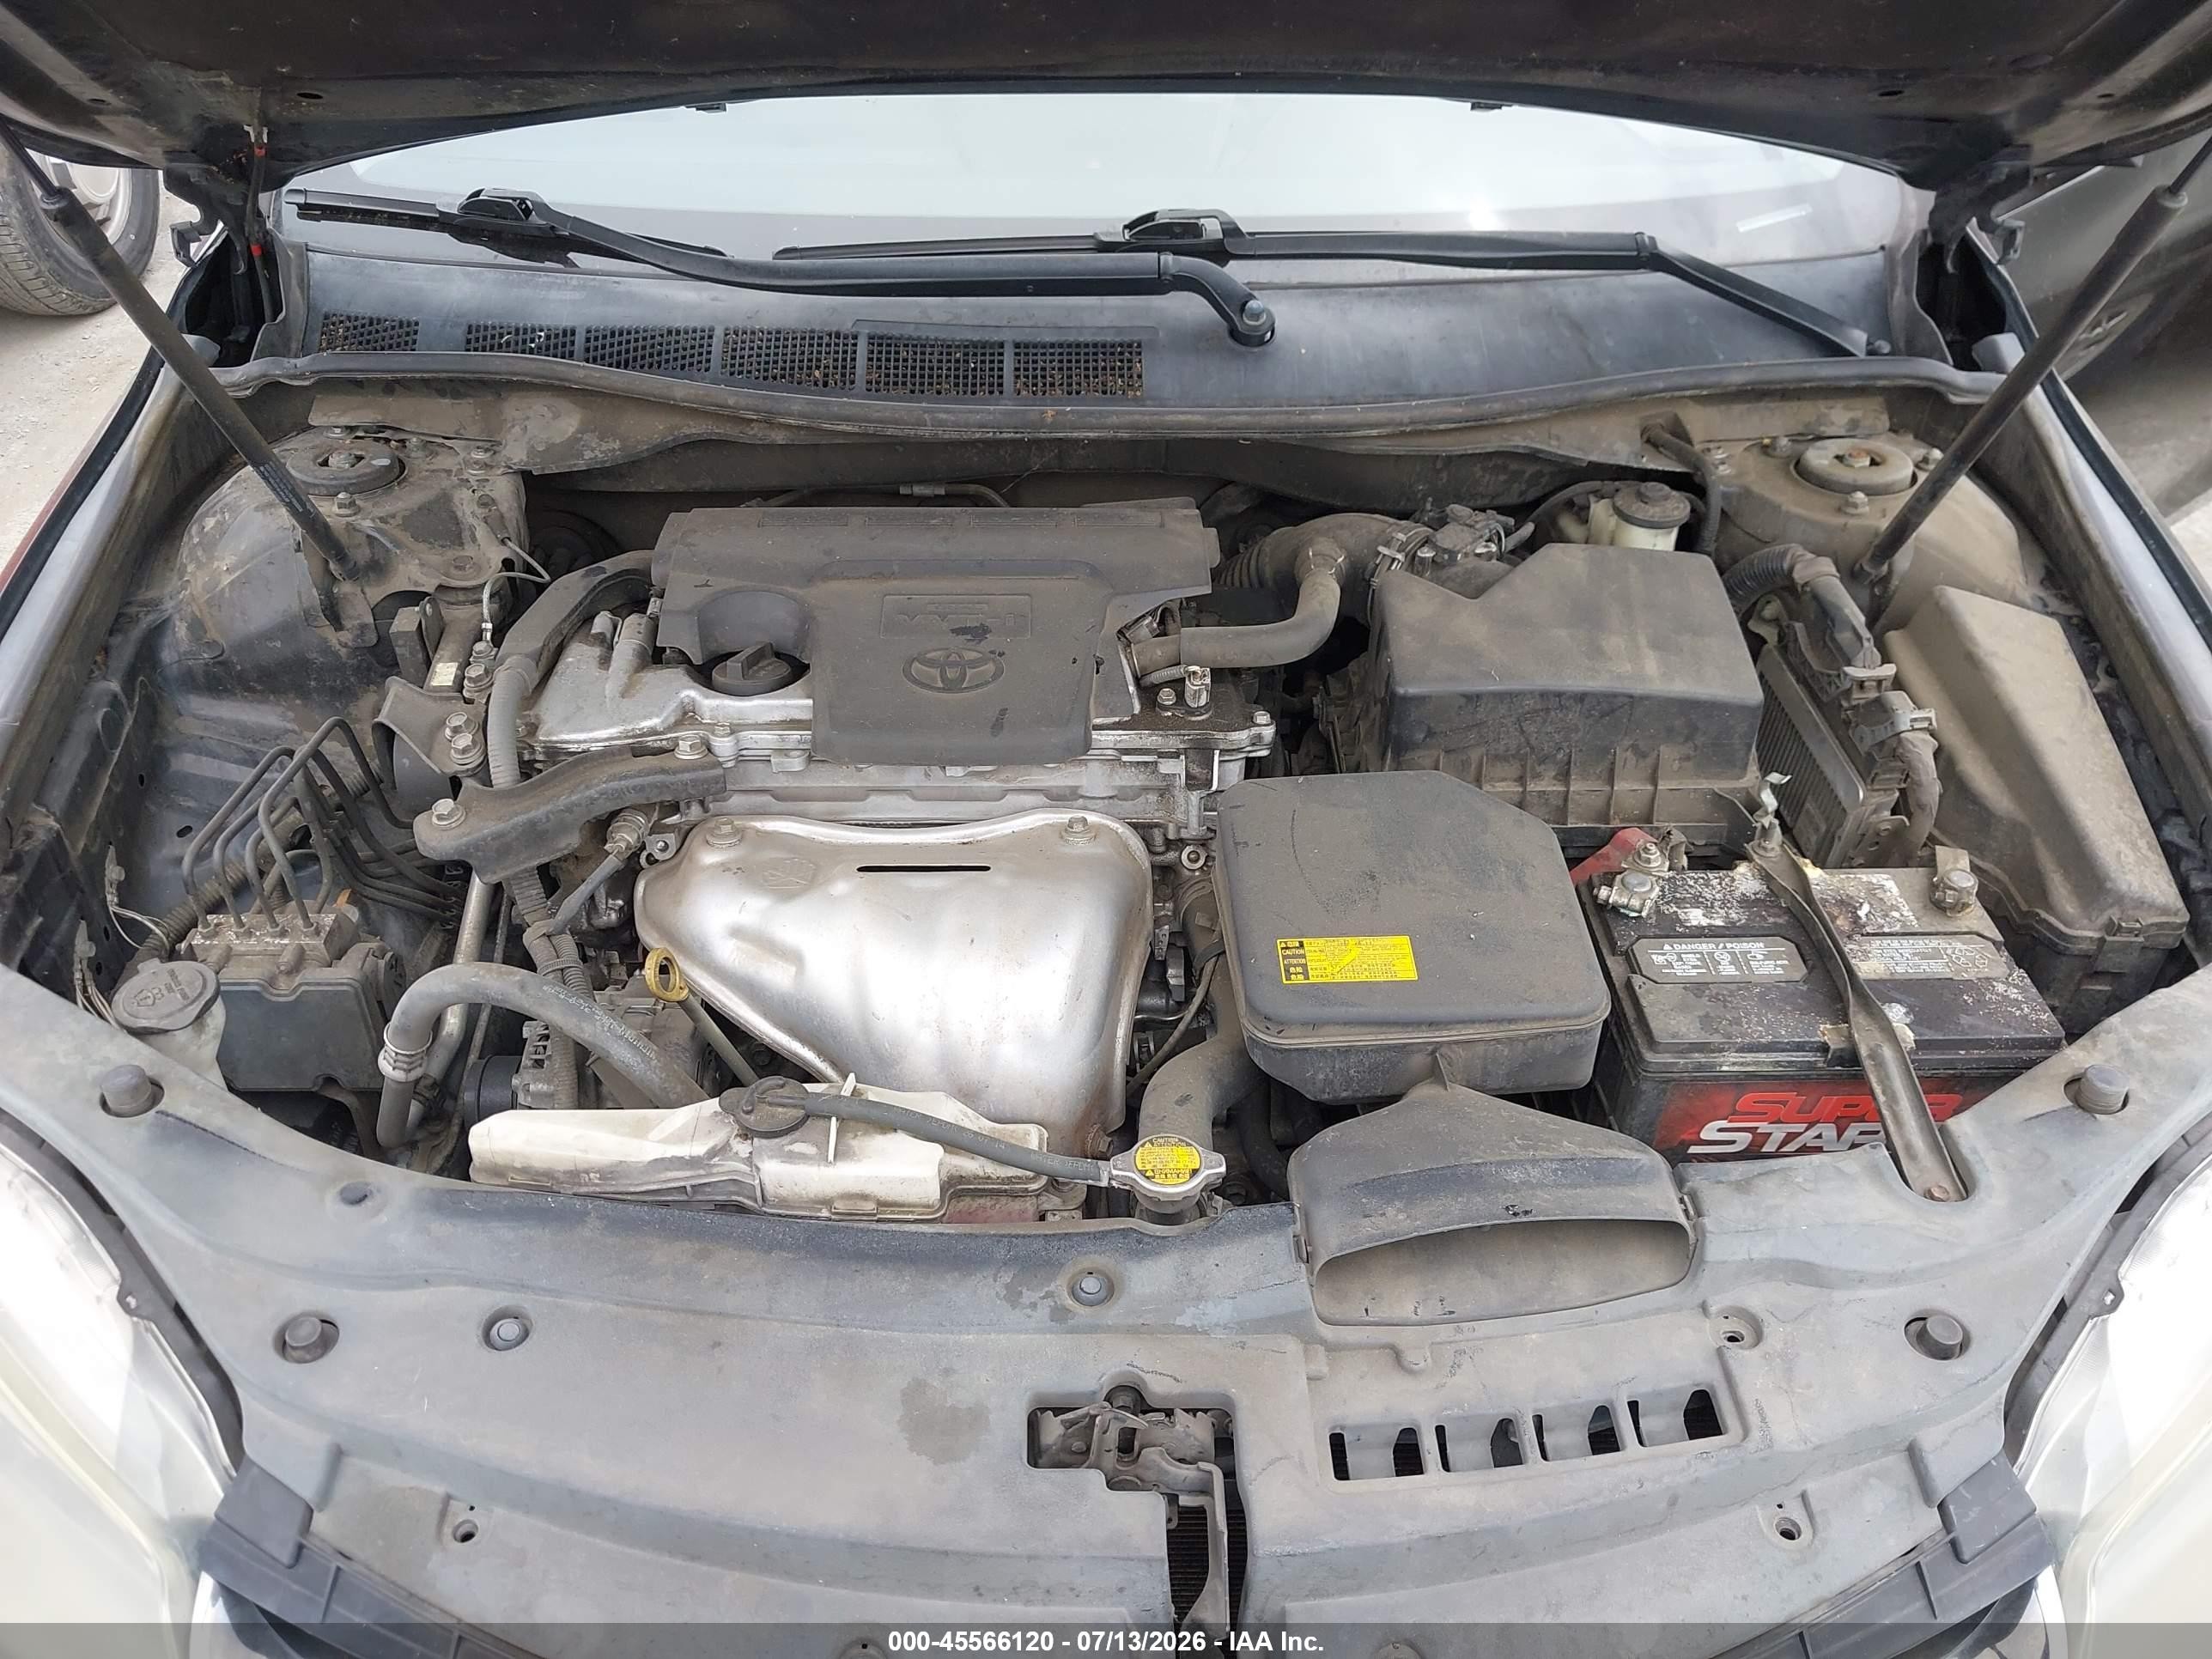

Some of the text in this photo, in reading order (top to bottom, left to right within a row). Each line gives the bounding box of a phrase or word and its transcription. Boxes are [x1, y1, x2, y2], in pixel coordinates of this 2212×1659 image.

[1674, 942, 1716, 951] DANGER
[1725, 941, 1765, 950] POISON
[1726, 1091, 1964, 1122] SUPR
[1686, 1120, 1887, 1154] STAR
